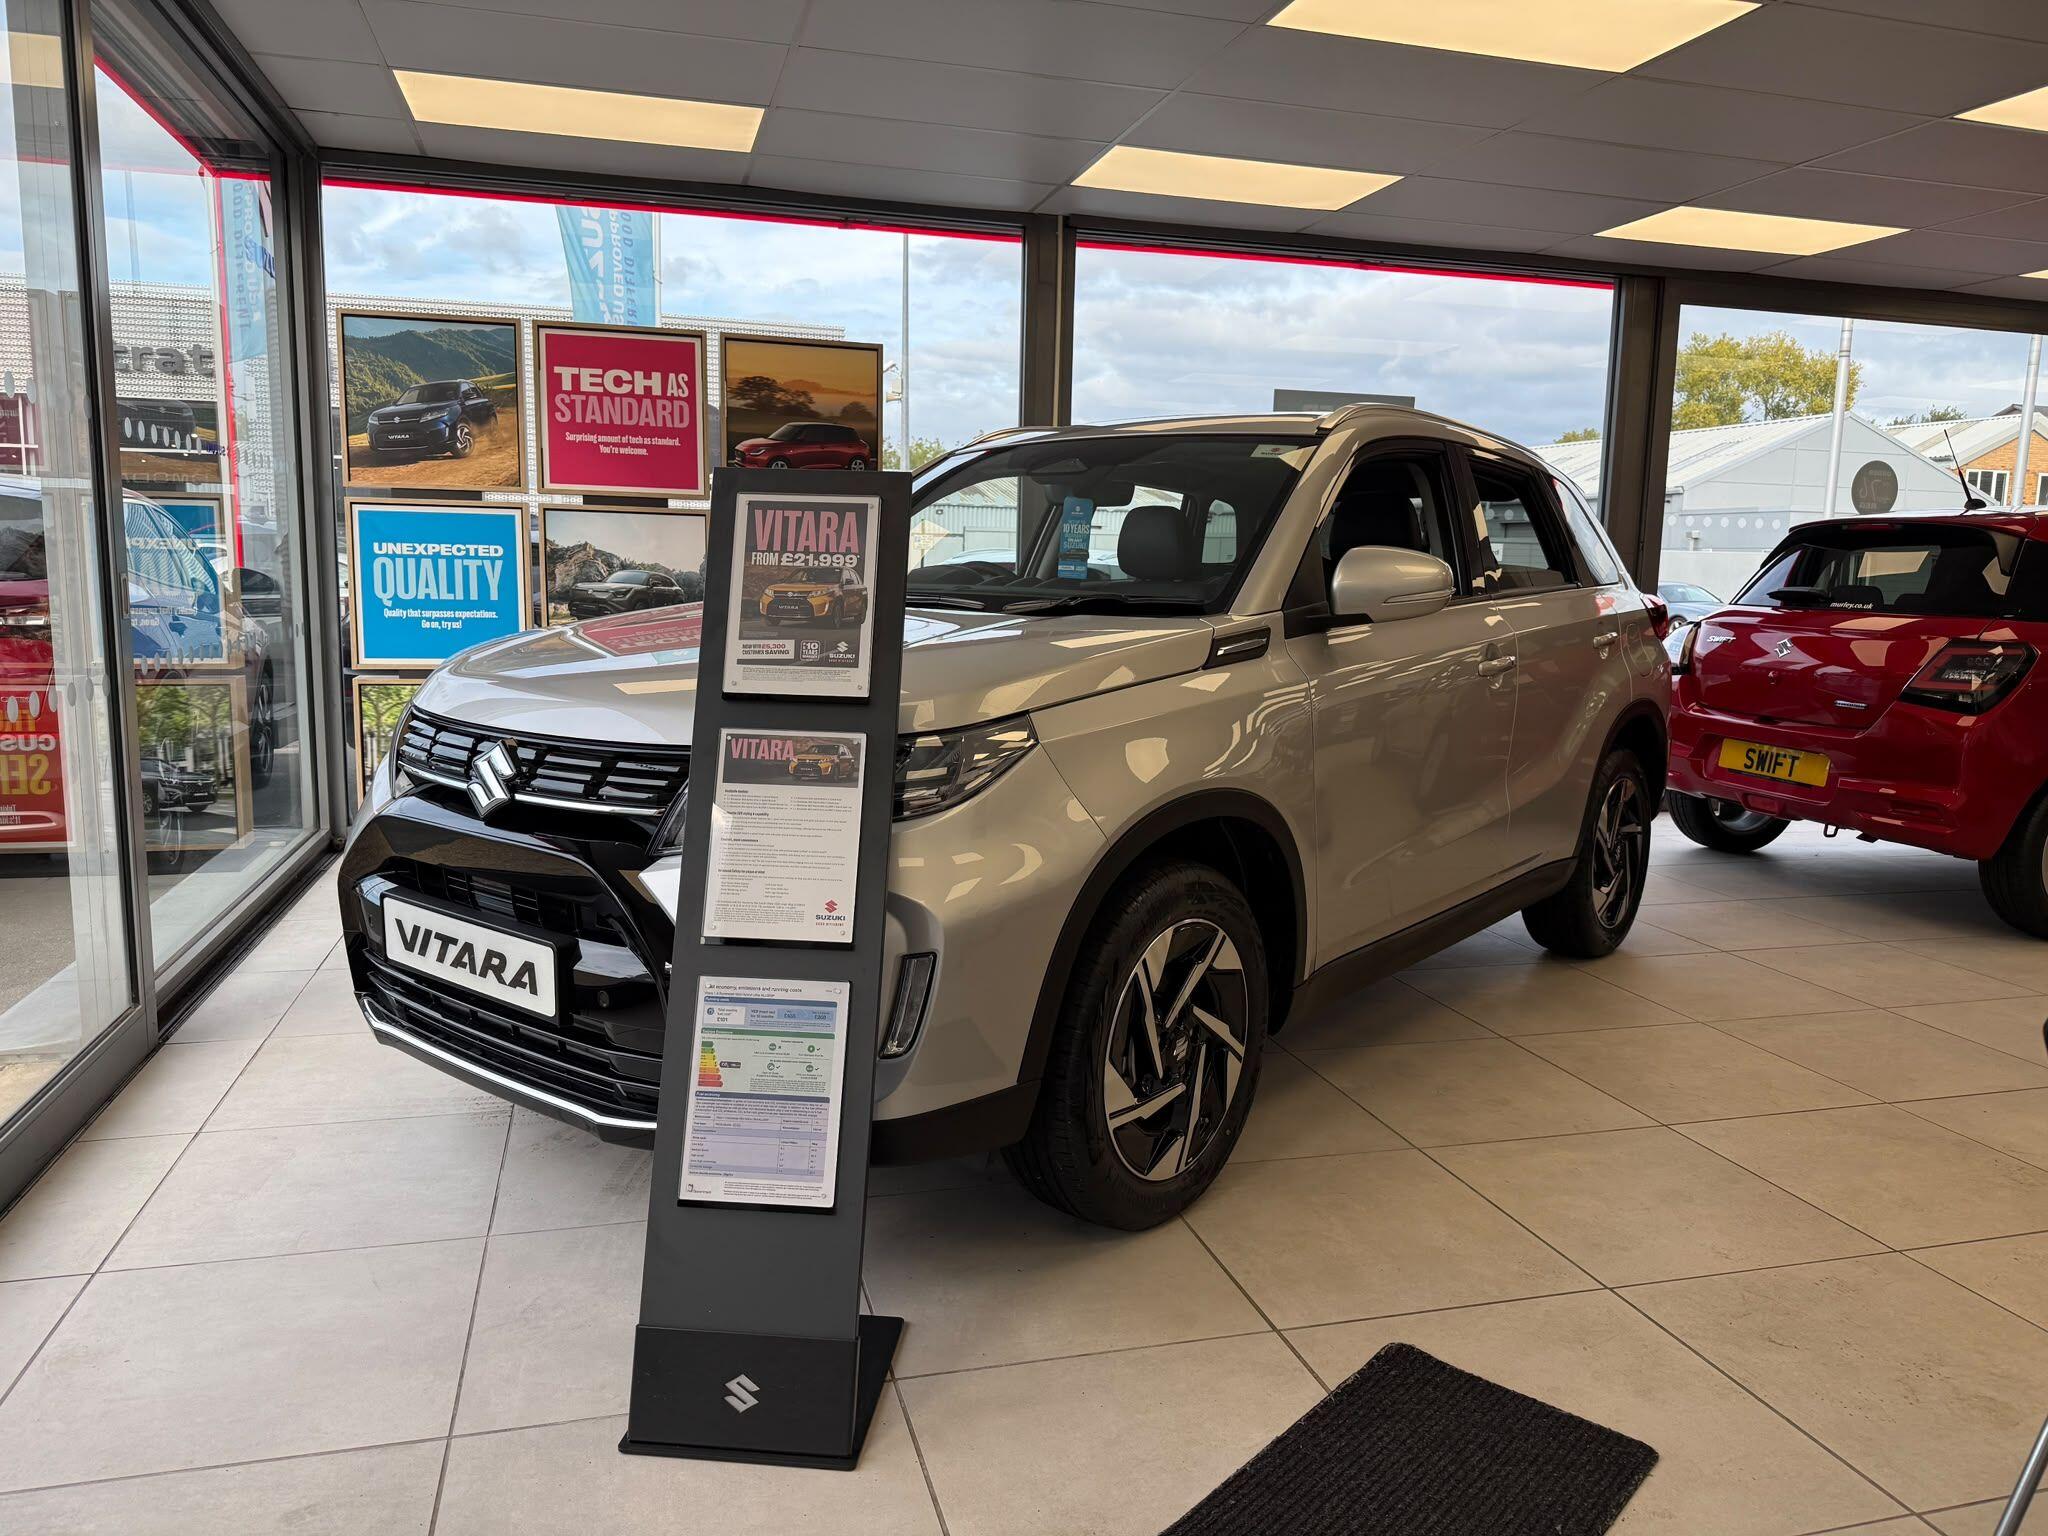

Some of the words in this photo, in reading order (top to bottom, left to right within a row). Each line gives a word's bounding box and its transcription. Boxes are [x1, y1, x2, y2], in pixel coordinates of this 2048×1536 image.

[553, 366, 662, 396] TECH
[666, 373, 689, 398] AS
[554, 393, 690, 428] STANDARD
[565, 432, 598, 444] Surprising
[597, 435, 621, 444] amount
[621, 435, 629, 444] of
[628, 435, 643, 445] tech
[643, 436, 652, 445] as
[651, 436, 681, 446] standard.
[599, 444, 619, 455] You're
[619, 445, 649, 456] welcome.
[754, 509, 860, 553] VITARA
[373, 542, 504, 557] UNEXPECTED
[751, 552, 779, 566] FROM
[373, 556, 504, 607] QUALITY
[1829, 601, 1875, 610] murley.co.uk
[383, 608, 407, 623] Quality
[407, 608, 421, 618] that
[421, 609, 455, 621] surpasses
[455, 609, 499, 621] expectations.
[421, 620, 430, 629] Go
[430, 621, 441, 630] on,
[441, 620, 452, 630] try
[452, 619, 462, 629] us!
[1706, 634, 1737, 644] SWIFT
[730, 737, 795, 761] VITARA
[1743, 747, 1800, 778] SWIFT
[395, 917, 539, 996] VITARA
